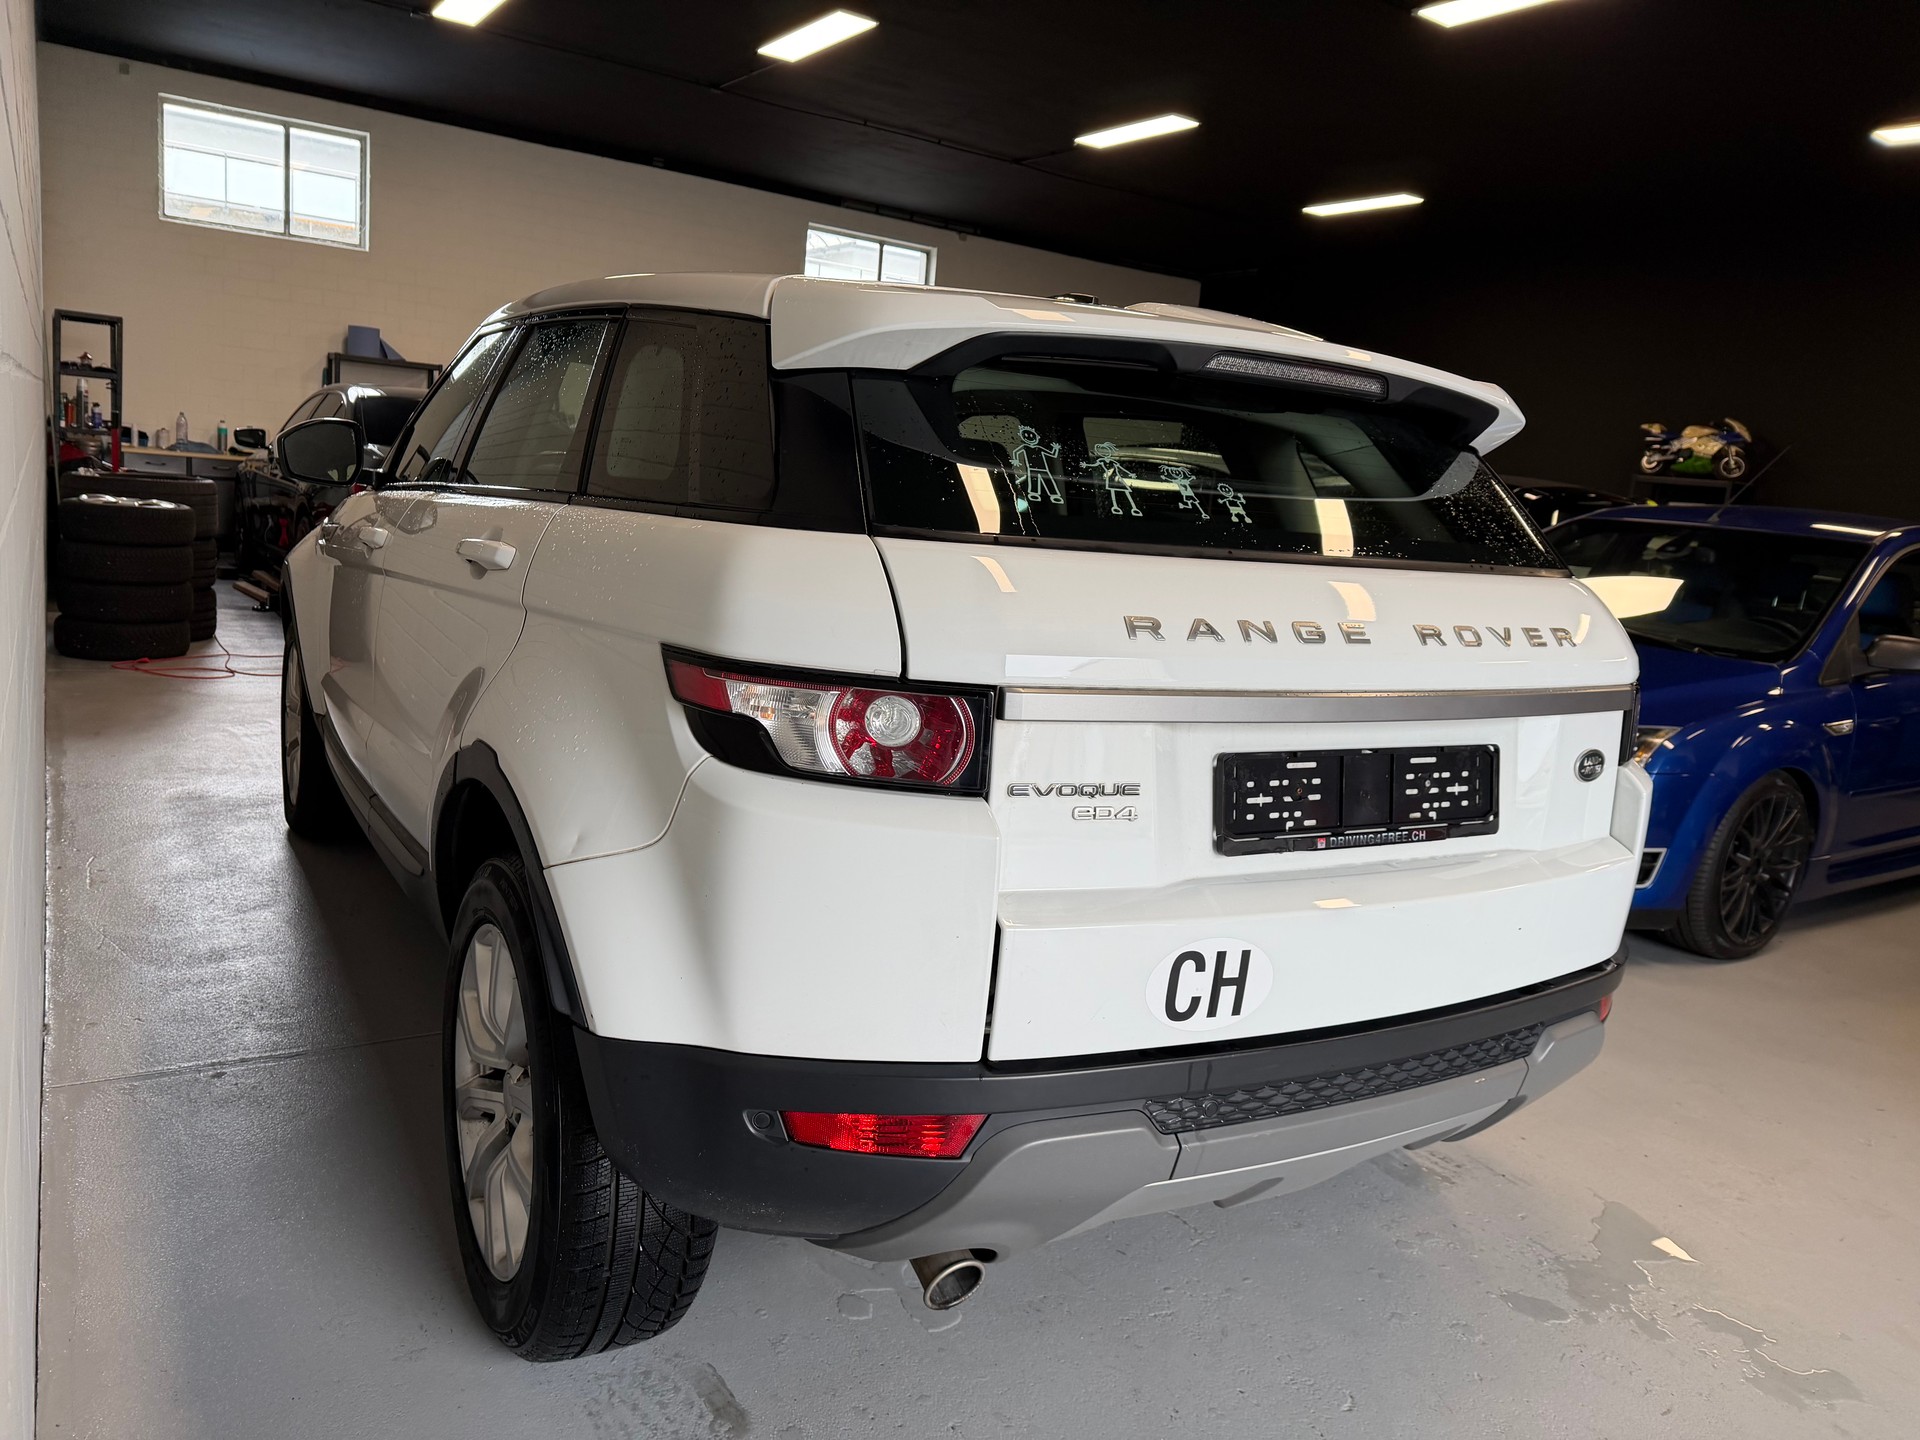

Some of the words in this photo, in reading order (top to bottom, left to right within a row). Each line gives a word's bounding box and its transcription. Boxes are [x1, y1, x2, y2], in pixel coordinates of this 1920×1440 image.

[1123, 615, 1371, 645] RANGE
[1412, 623, 1577, 647] ROVER
[1007, 783, 1141, 799] EVOQUE
[1330, 830, 1426, 848] DRIVING4FREE.CH
[1165, 949, 1251, 1022] CH
